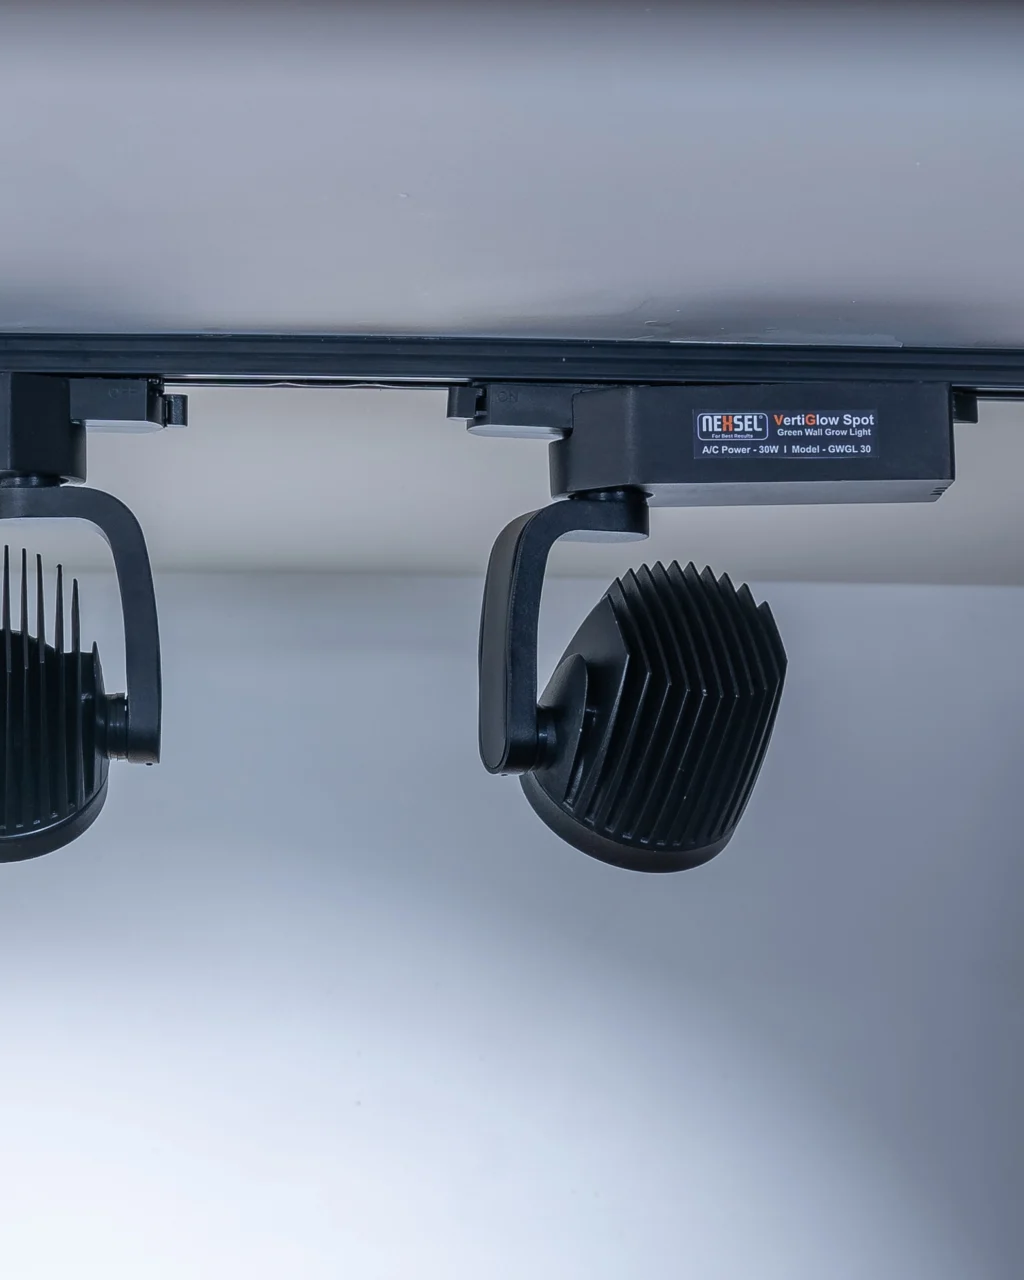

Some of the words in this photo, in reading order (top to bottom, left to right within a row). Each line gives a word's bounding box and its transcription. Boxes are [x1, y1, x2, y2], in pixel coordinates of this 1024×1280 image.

[774, 415, 839, 426] VertiGlow
[843, 414, 874, 428] Spot
[804, 428, 823, 436] Wall
[849, 428, 871, 437] Light
[702, 446, 719, 454] A/C
[721, 446, 751, 454] Power
[759, 445, 779, 454] 30W
[792, 445, 820, 454] Model
[828, 445, 858, 453] GWGL
[860, 445, 871, 453] 30
